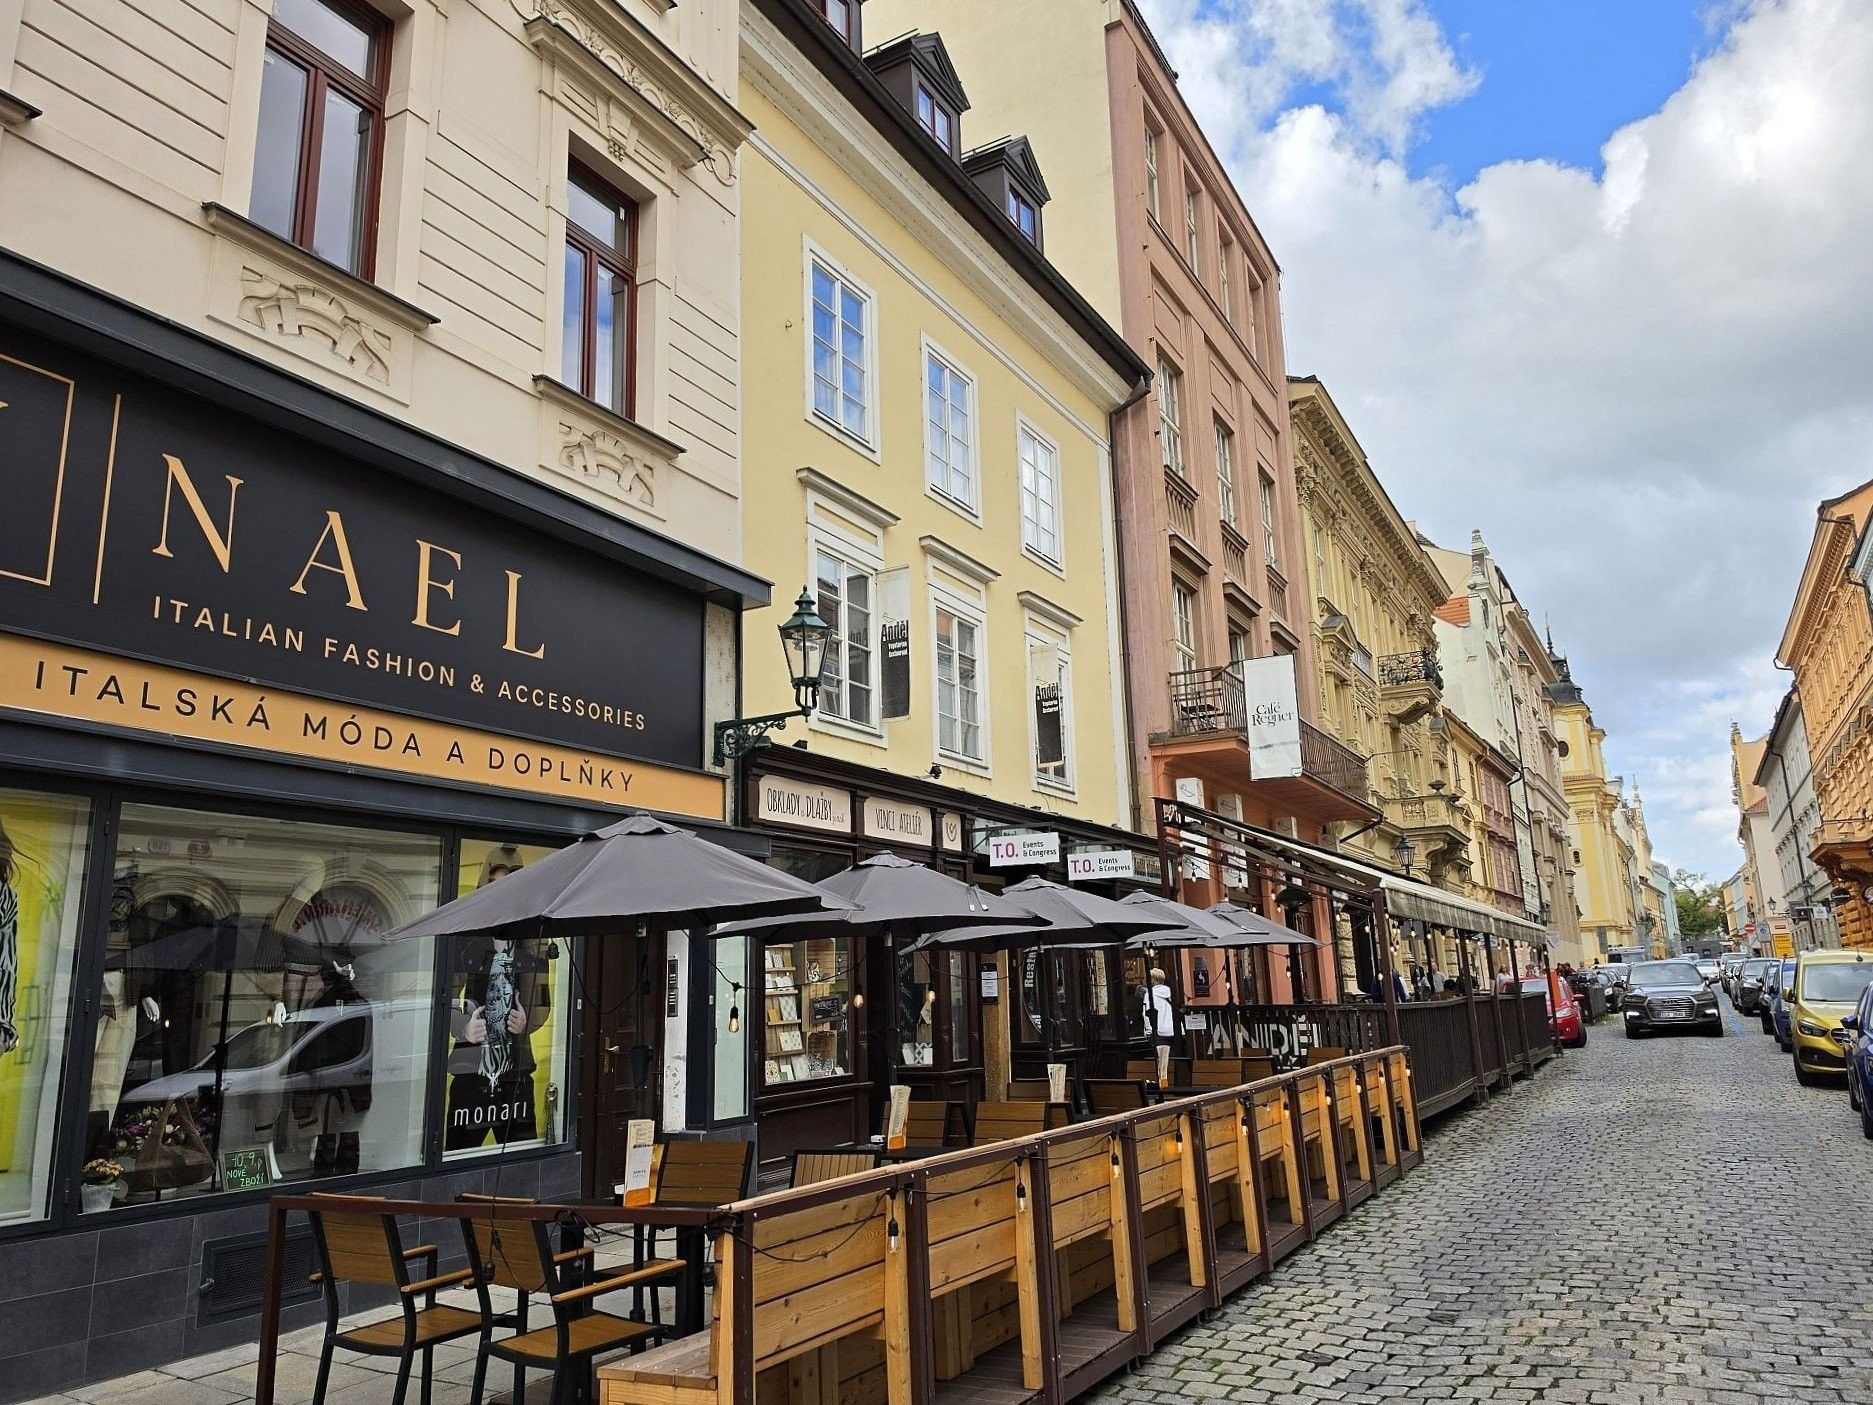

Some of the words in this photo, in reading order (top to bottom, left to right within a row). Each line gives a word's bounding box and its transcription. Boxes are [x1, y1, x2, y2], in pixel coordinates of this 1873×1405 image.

[152, 453, 546, 660] NAEL
[881, 619, 909, 641] Anděl
[153, 595, 304, 652] ITALIAN
[323, 636, 456, 688] FASHION
[469, 673, 485, 694] &
[497, 679, 646, 731] ACCESSORIES
[1035, 682, 1059, 701] Anděl
[1256, 702, 1281, 715] Café
[35, 660, 271, 731] ITALSKÁ
[302, 712, 422, 757] MÓDA
[446, 741, 465, 764] A
[488, 747, 634, 792] DOPLŇKY
[1252, 712, 1295, 728] Regner
[766, 787, 801, 818] OBKLADY
[806, 791, 833, 821] DLAŽBY
[992, 843, 1019, 859] T.O.
[1023, 841, 1044, 849] Events
[1028, 848, 1057, 858] Congress
[1071, 859, 1095, 874] T.O.
[1098, 857, 1118, 865] Events
[1104, 863, 1131, 873] Congress
[454, 1101, 527, 1127] monari
